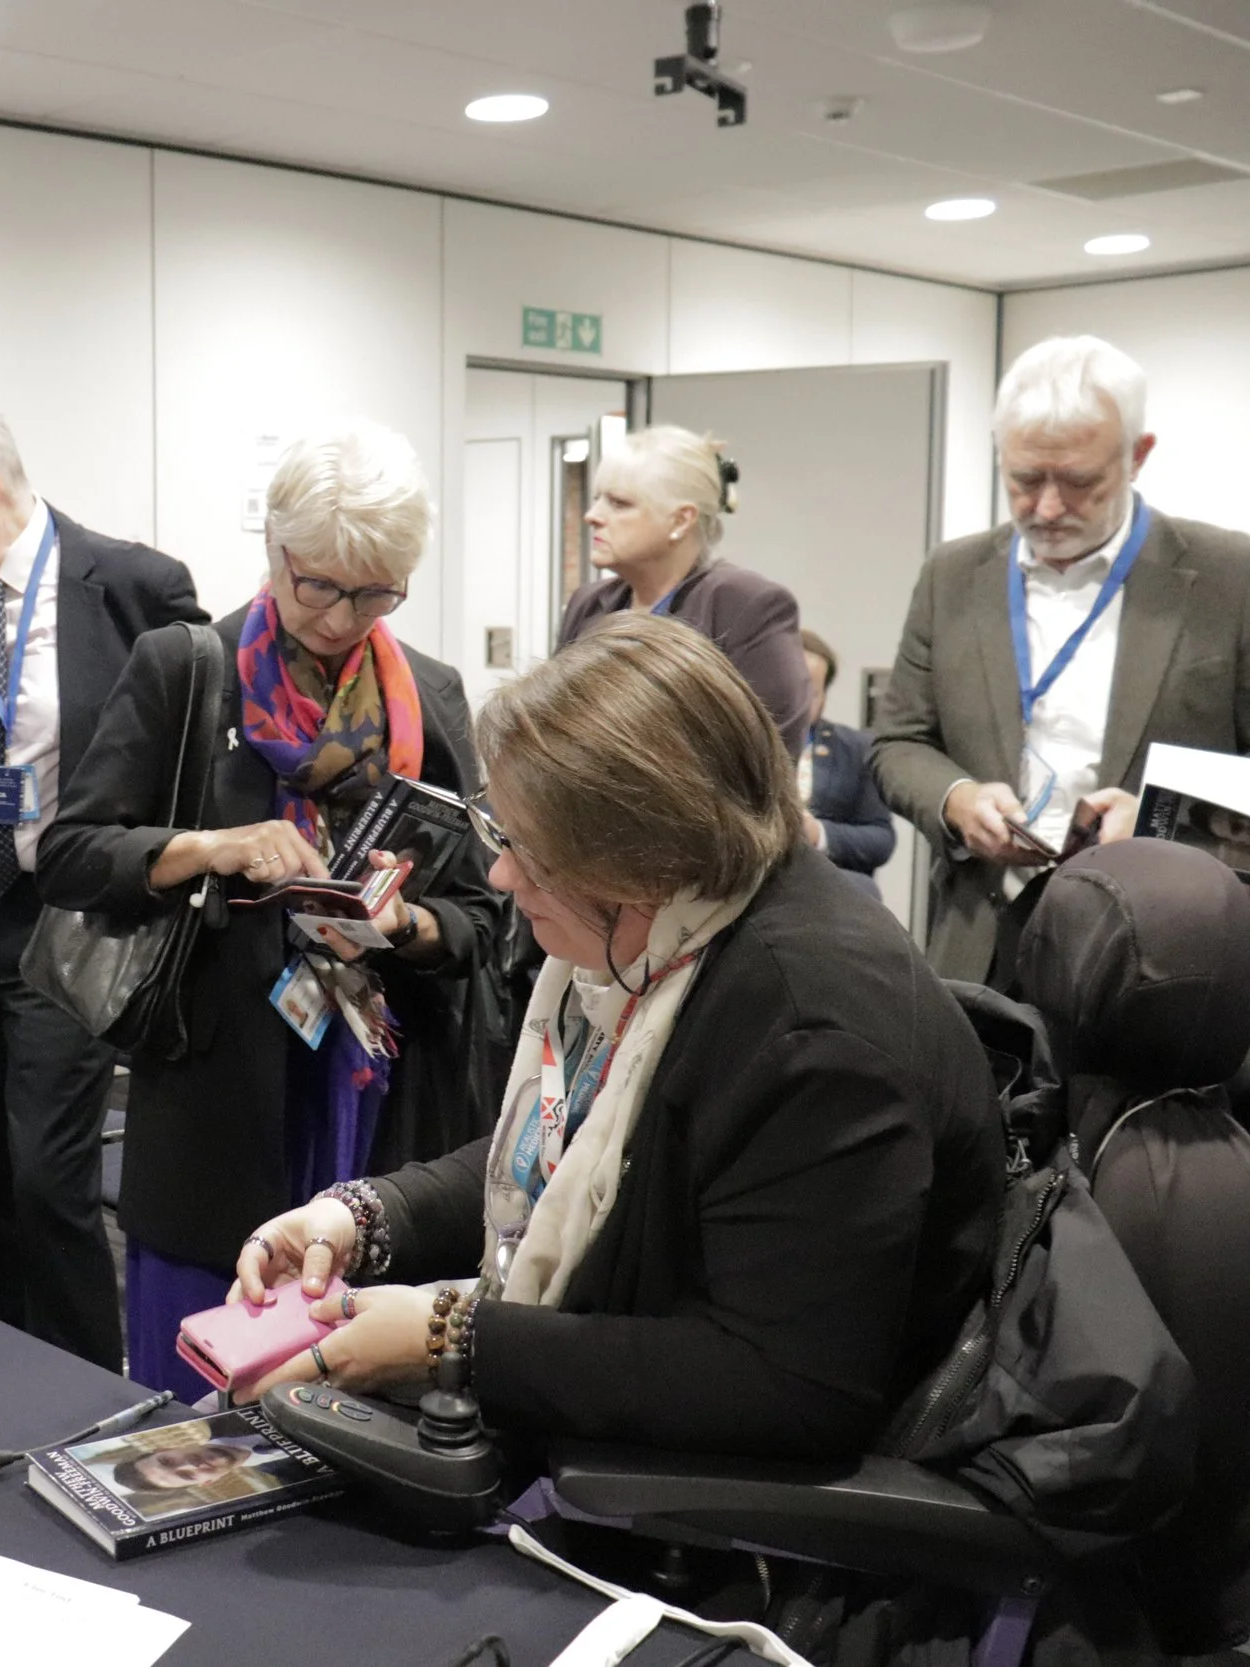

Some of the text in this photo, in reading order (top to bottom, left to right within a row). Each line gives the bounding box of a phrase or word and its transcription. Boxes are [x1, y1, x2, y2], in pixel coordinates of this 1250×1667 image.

[343, 800, 379, 852] BLUEPRINT
[356, 808, 394, 859] BLUEPRINT
[46, 1450, 136, 1527] GOODWIN-FREEMAN
[54, 1471, 104, 1511] MATTHEW
[145, 1534, 157, 1548] A
[159, 1514, 236, 1545] BLUEPRINT
